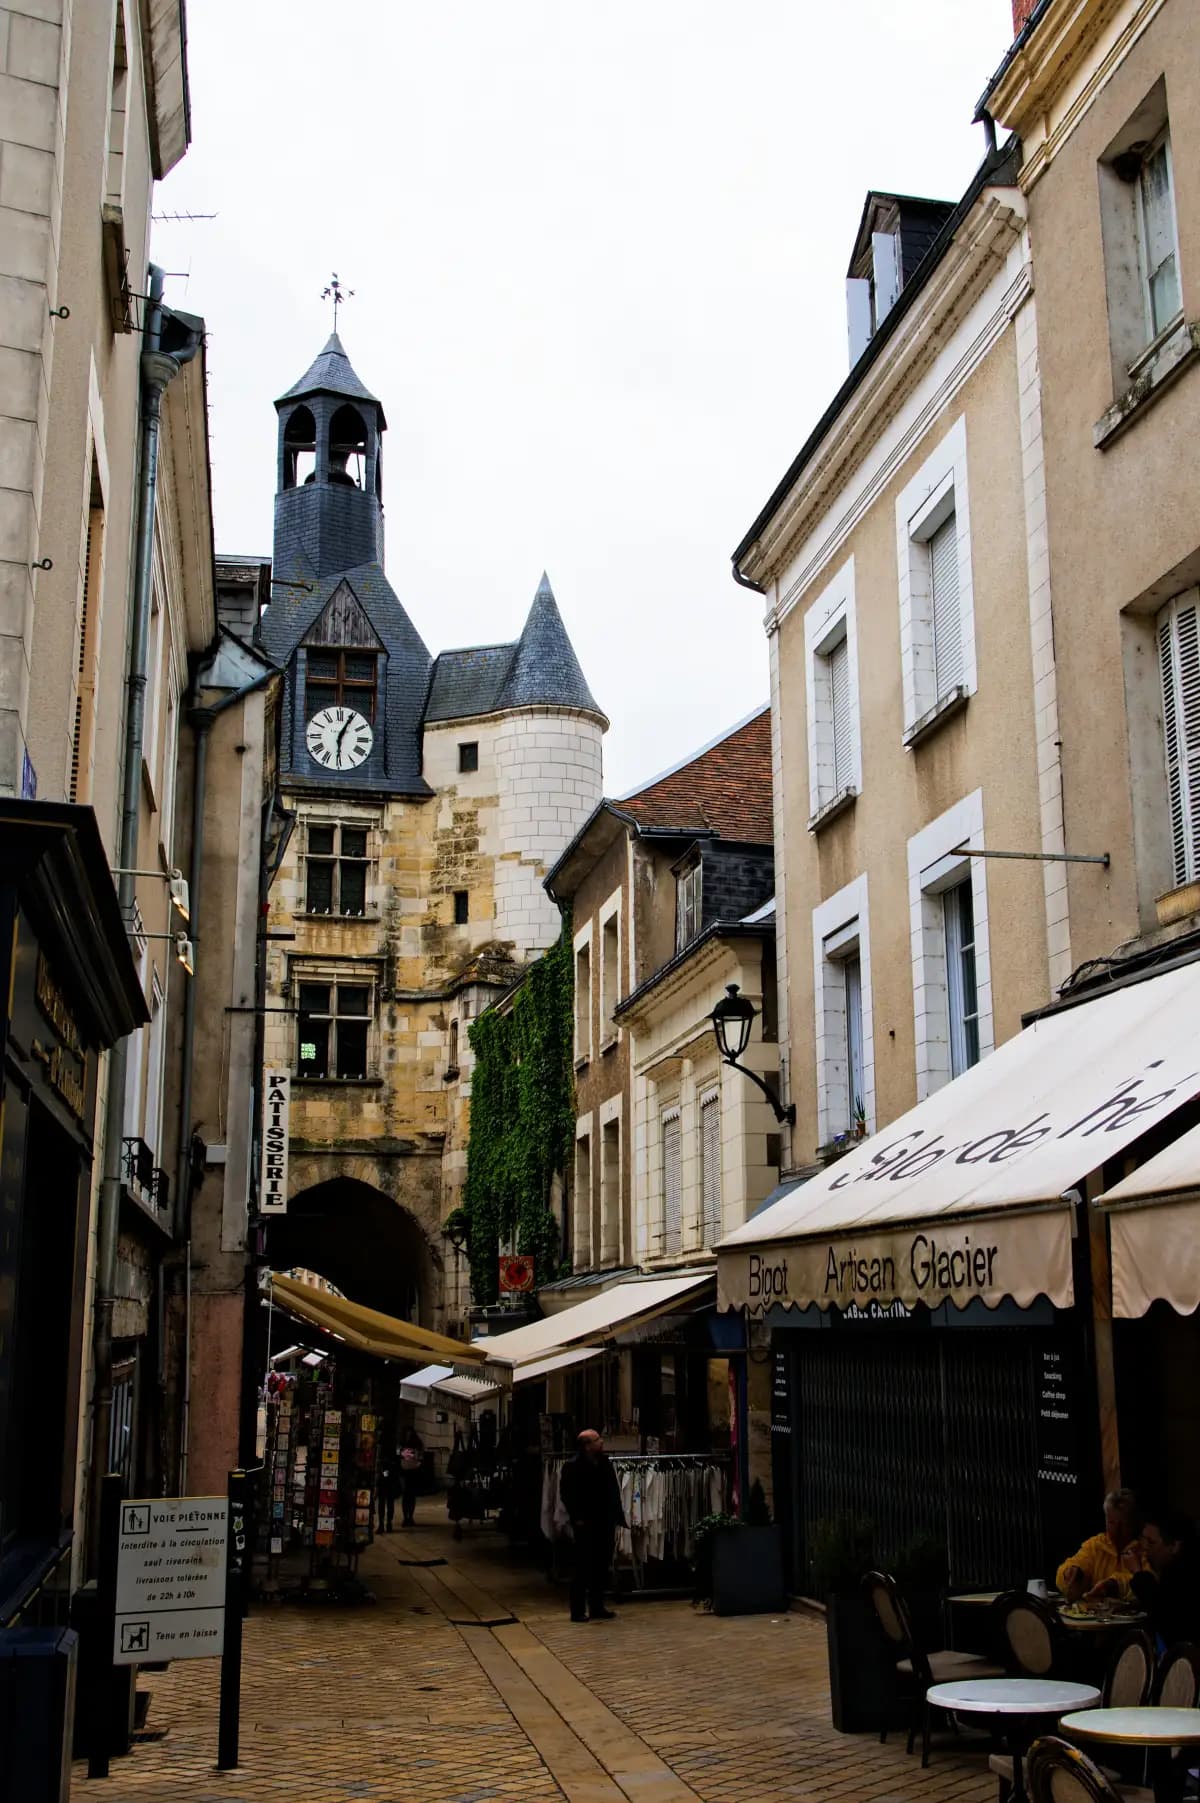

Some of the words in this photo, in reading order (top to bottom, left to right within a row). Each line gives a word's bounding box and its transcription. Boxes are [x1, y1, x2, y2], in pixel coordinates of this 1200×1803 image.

[827, 1130, 972, 1191] Salo
[955, 1112, 1052, 1164] de
[1057, 1058, 1199, 1139] hé
[265, 1075, 287, 1206] PATISSERIE
[749, 1254, 788, 1305] Bigot
[824, 1245, 895, 1294] Artisan
[910, 1234, 998, 1290] Glacier
[153, 1514, 175, 1523] VOIE
[178, 1510, 226, 1522] PIÉTONNE
[121, 1540, 158, 1550] Interdite
[161, 1539, 166, 1548] à
[169, 1539, 177, 1547] la
[180, 1537, 225, 1547] circulation
[143, 1557, 162, 1567] sauf
[166, 1555, 203, 1566] riverains
[135, 1576, 174, 1585] livraisons
[177, 1573, 208, 1582] tolérées
[146, 1593, 156, 1601] de
[160, 1592, 174, 1600] 22h
[183, 1590, 196, 1598] 10h
[156, 1631, 175, 1640] Tenu
[193, 1628, 218, 1638] laisse
